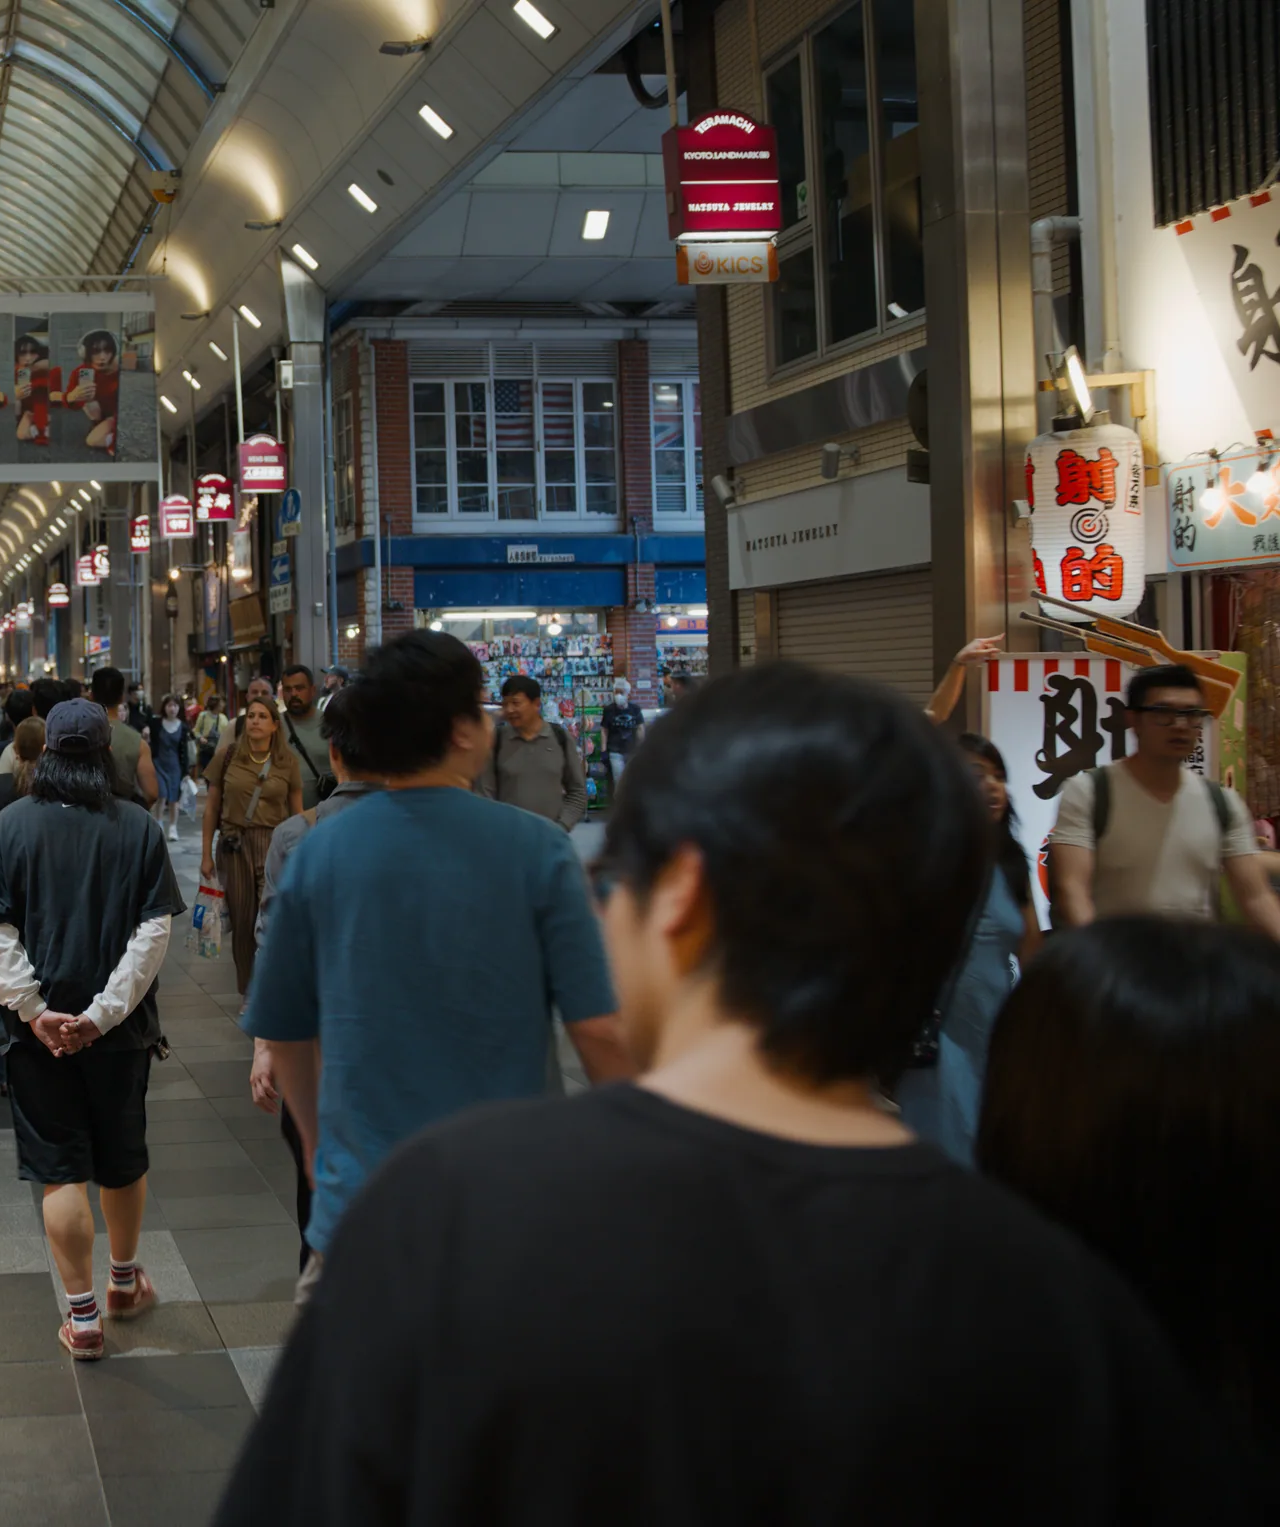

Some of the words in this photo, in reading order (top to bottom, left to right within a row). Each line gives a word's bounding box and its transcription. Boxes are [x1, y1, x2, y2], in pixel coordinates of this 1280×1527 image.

[694, 114, 756, 134] TERAMACHI
[733, 202, 774, 211] JEWELRY
[717, 255, 764, 274] KICS
[1172, 475, 1197, 553] 射的
[791, 523, 839, 543] JEWELRY
